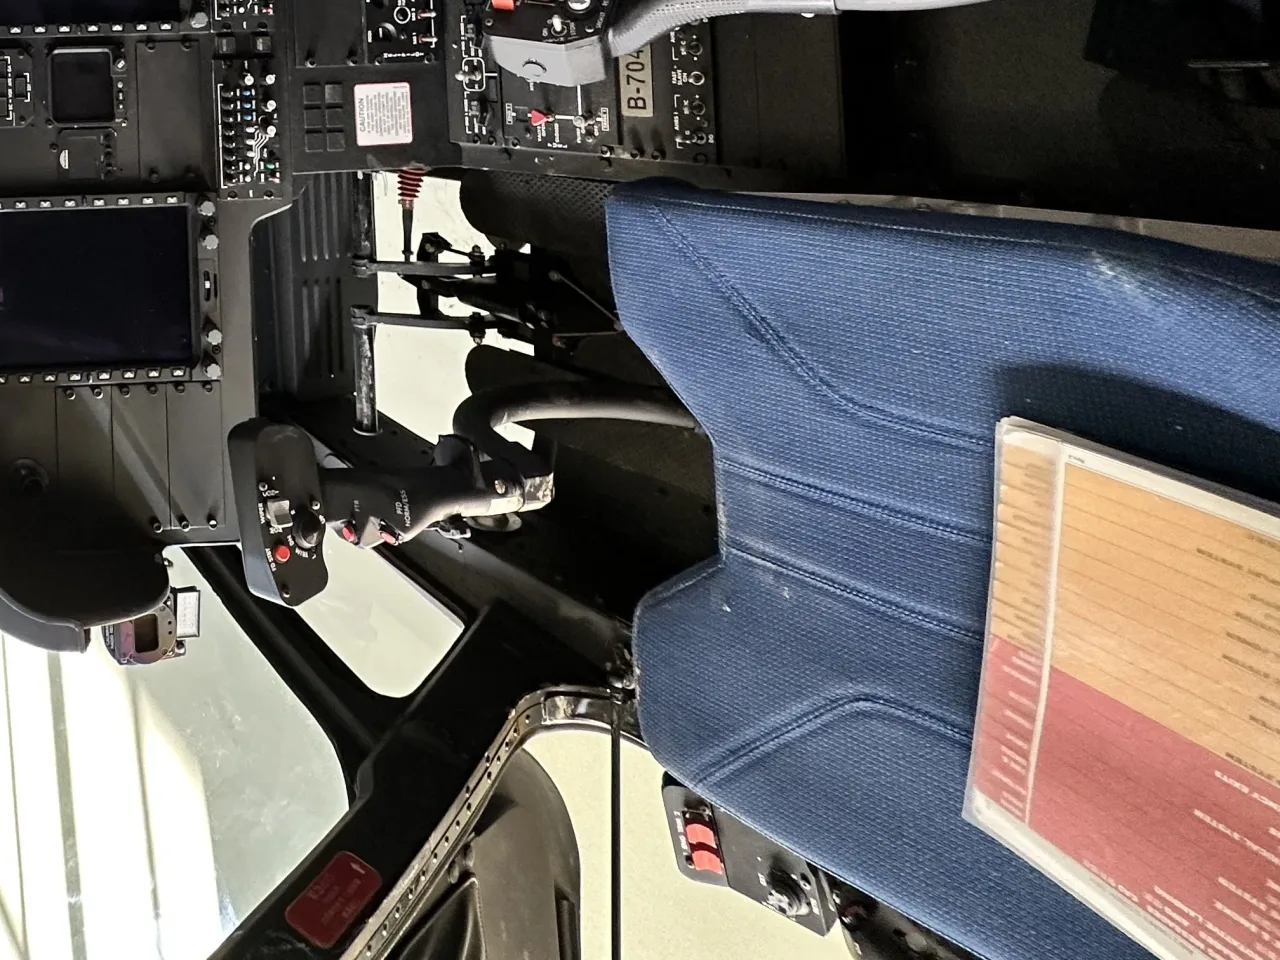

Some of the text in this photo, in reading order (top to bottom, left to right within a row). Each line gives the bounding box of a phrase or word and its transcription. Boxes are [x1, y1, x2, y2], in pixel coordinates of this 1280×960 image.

[357, 98, 366, 132] CAUTION
[258, 502, 266, 524] WIPER
[394, 501, 404, 515] PFD
[399, 489, 411, 527] NORM/ESS
